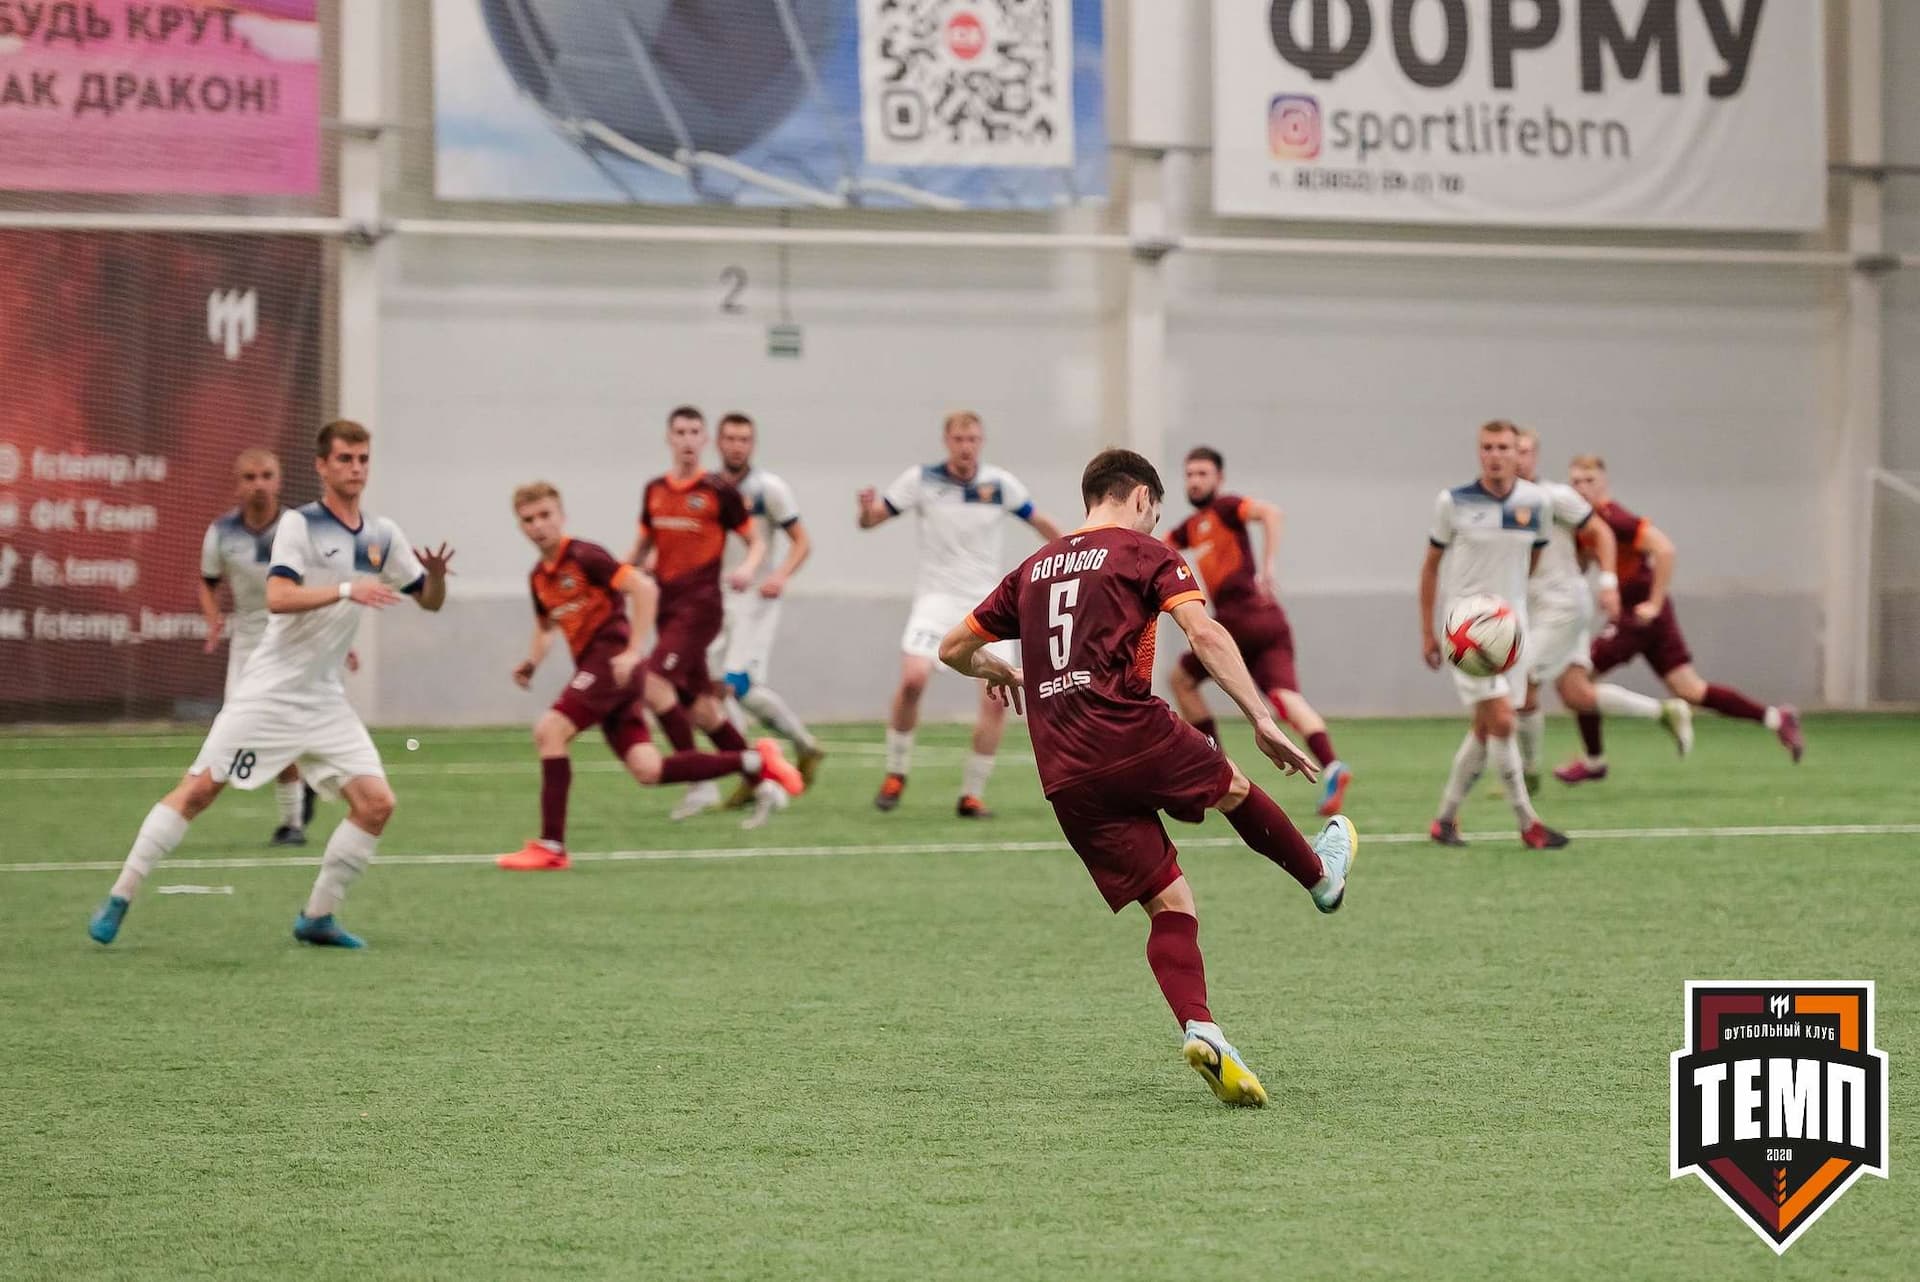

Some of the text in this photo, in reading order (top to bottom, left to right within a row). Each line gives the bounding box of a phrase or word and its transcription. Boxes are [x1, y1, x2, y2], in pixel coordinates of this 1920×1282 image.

[1270, 0, 1765, 98] ФОРМУ
[74, 71, 280, 116] ДРАКОН!
[1329, 102, 1631, 161] sportlifebrn
[720, 265, 748, 315] 2
[32, 448, 167, 485] fctemp.ru
[30, 499, 158, 531] ФК Темп
[1031, 548, 1109, 583] БОРИСОВ
[1048, 578, 1081, 671] 5
[1039, 670, 1091, 699] SEUS
[228, 748, 256, 779] 18
